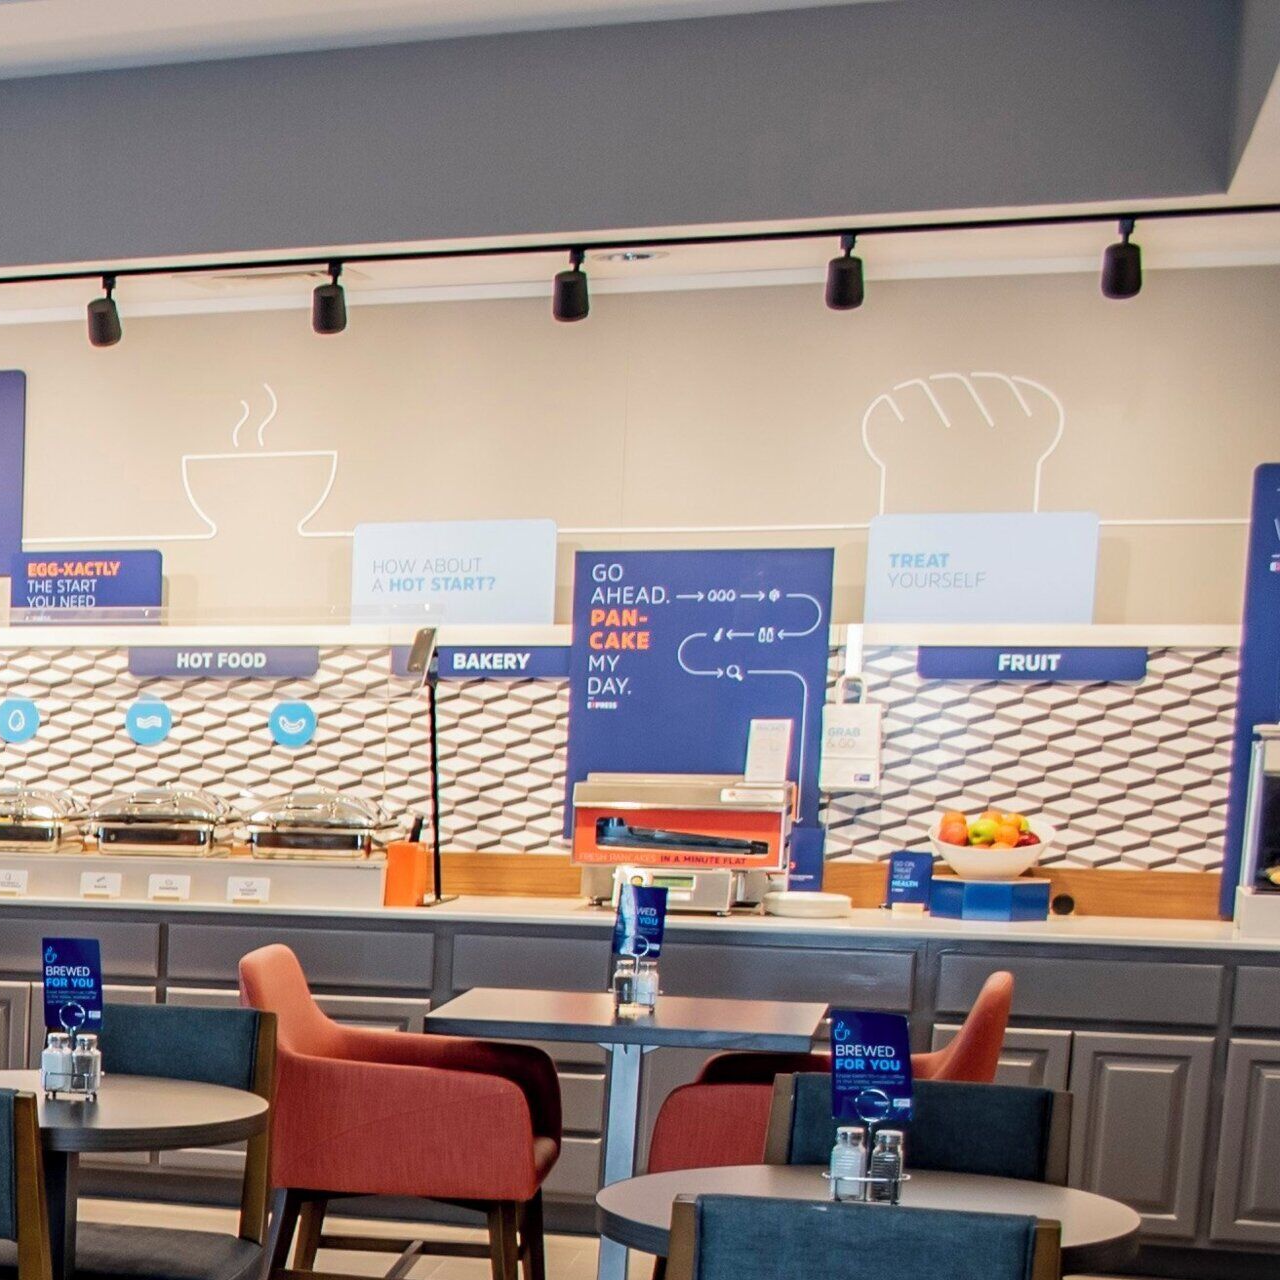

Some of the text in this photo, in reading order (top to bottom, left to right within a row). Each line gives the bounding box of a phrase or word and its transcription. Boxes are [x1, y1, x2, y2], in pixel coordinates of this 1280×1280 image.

[27, 561, 121, 577] EGG-XACTLY
[372, 556, 482, 576] HOW ABOUT
[888, 552, 950, 569] TREAT
[591, 563, 624, 583] GO
[887, 571, 987, 590] YOURSELF
[27, 578, 98, 594] THE START
[372, 574, 496, 593] A HOT START?
[27, 594, 96, 608] YOU NEED
[591, 585, 671, 605] AHEAD.
[591, 609, 649, 627] PAN-
[589, 631, 650, 650] CAKE
[177, 651, 267, 670] HOT FOOD
[453, 652, 531, 671] BAKERY
[588, 654, 621, 673] MY
[997, 653, 1062, 672] FRUIT
[587, 675, 632, 697] DAY.
[828, 727, 861, 738] GRAB
[684, 855, 720, 864] MINUTE
[723, 857, 746, 865] FLAT
[45, 965, 91, 978] BREWED
[45, 977, 94, 988] FOR YOU
[835, 1044, 895, 1058] BREWED
[835, 1058, 901, 1072] FOR YOU
